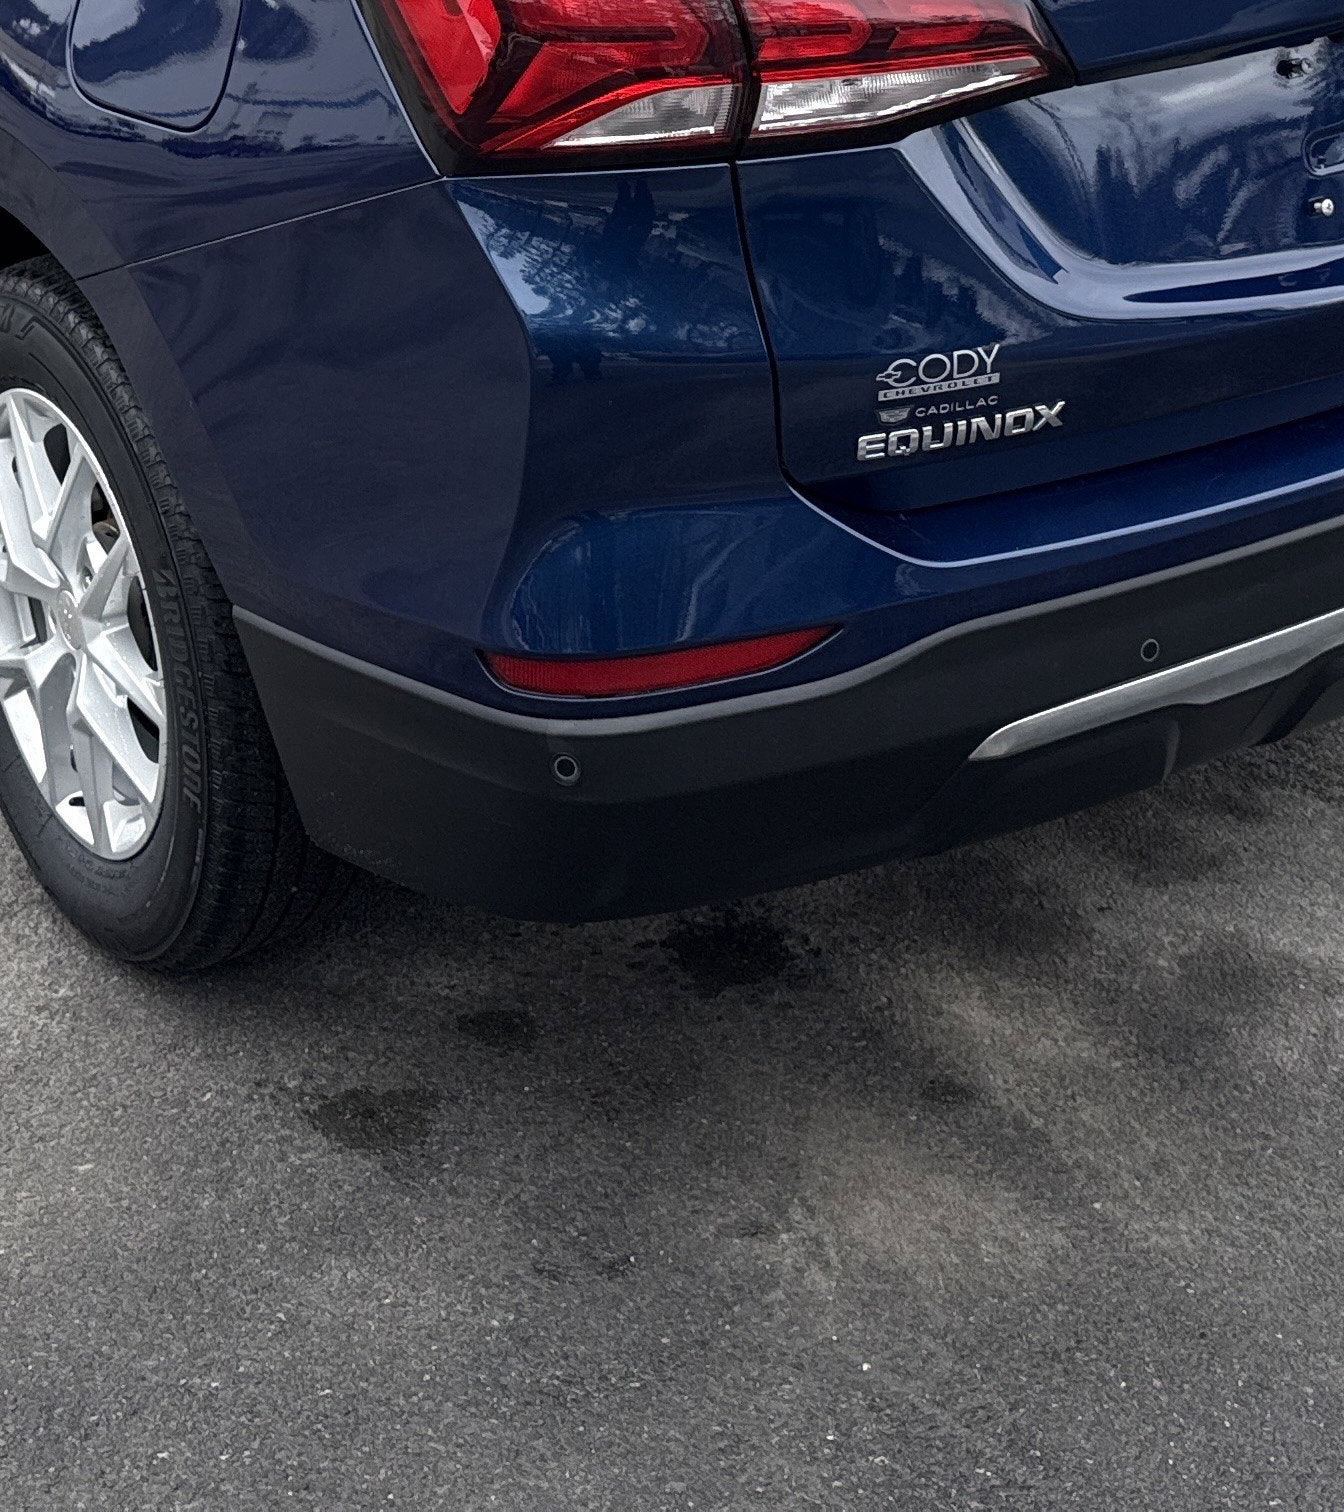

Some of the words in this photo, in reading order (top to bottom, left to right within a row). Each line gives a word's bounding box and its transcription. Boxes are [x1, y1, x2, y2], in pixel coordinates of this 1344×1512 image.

[876, 343, 1001, 387] CODY
[882, 374, 995, 399] CHEVROLET
[915, 395, 999, 418] CADILLAC
[857, 400, 1066, 461] EQUINOX
